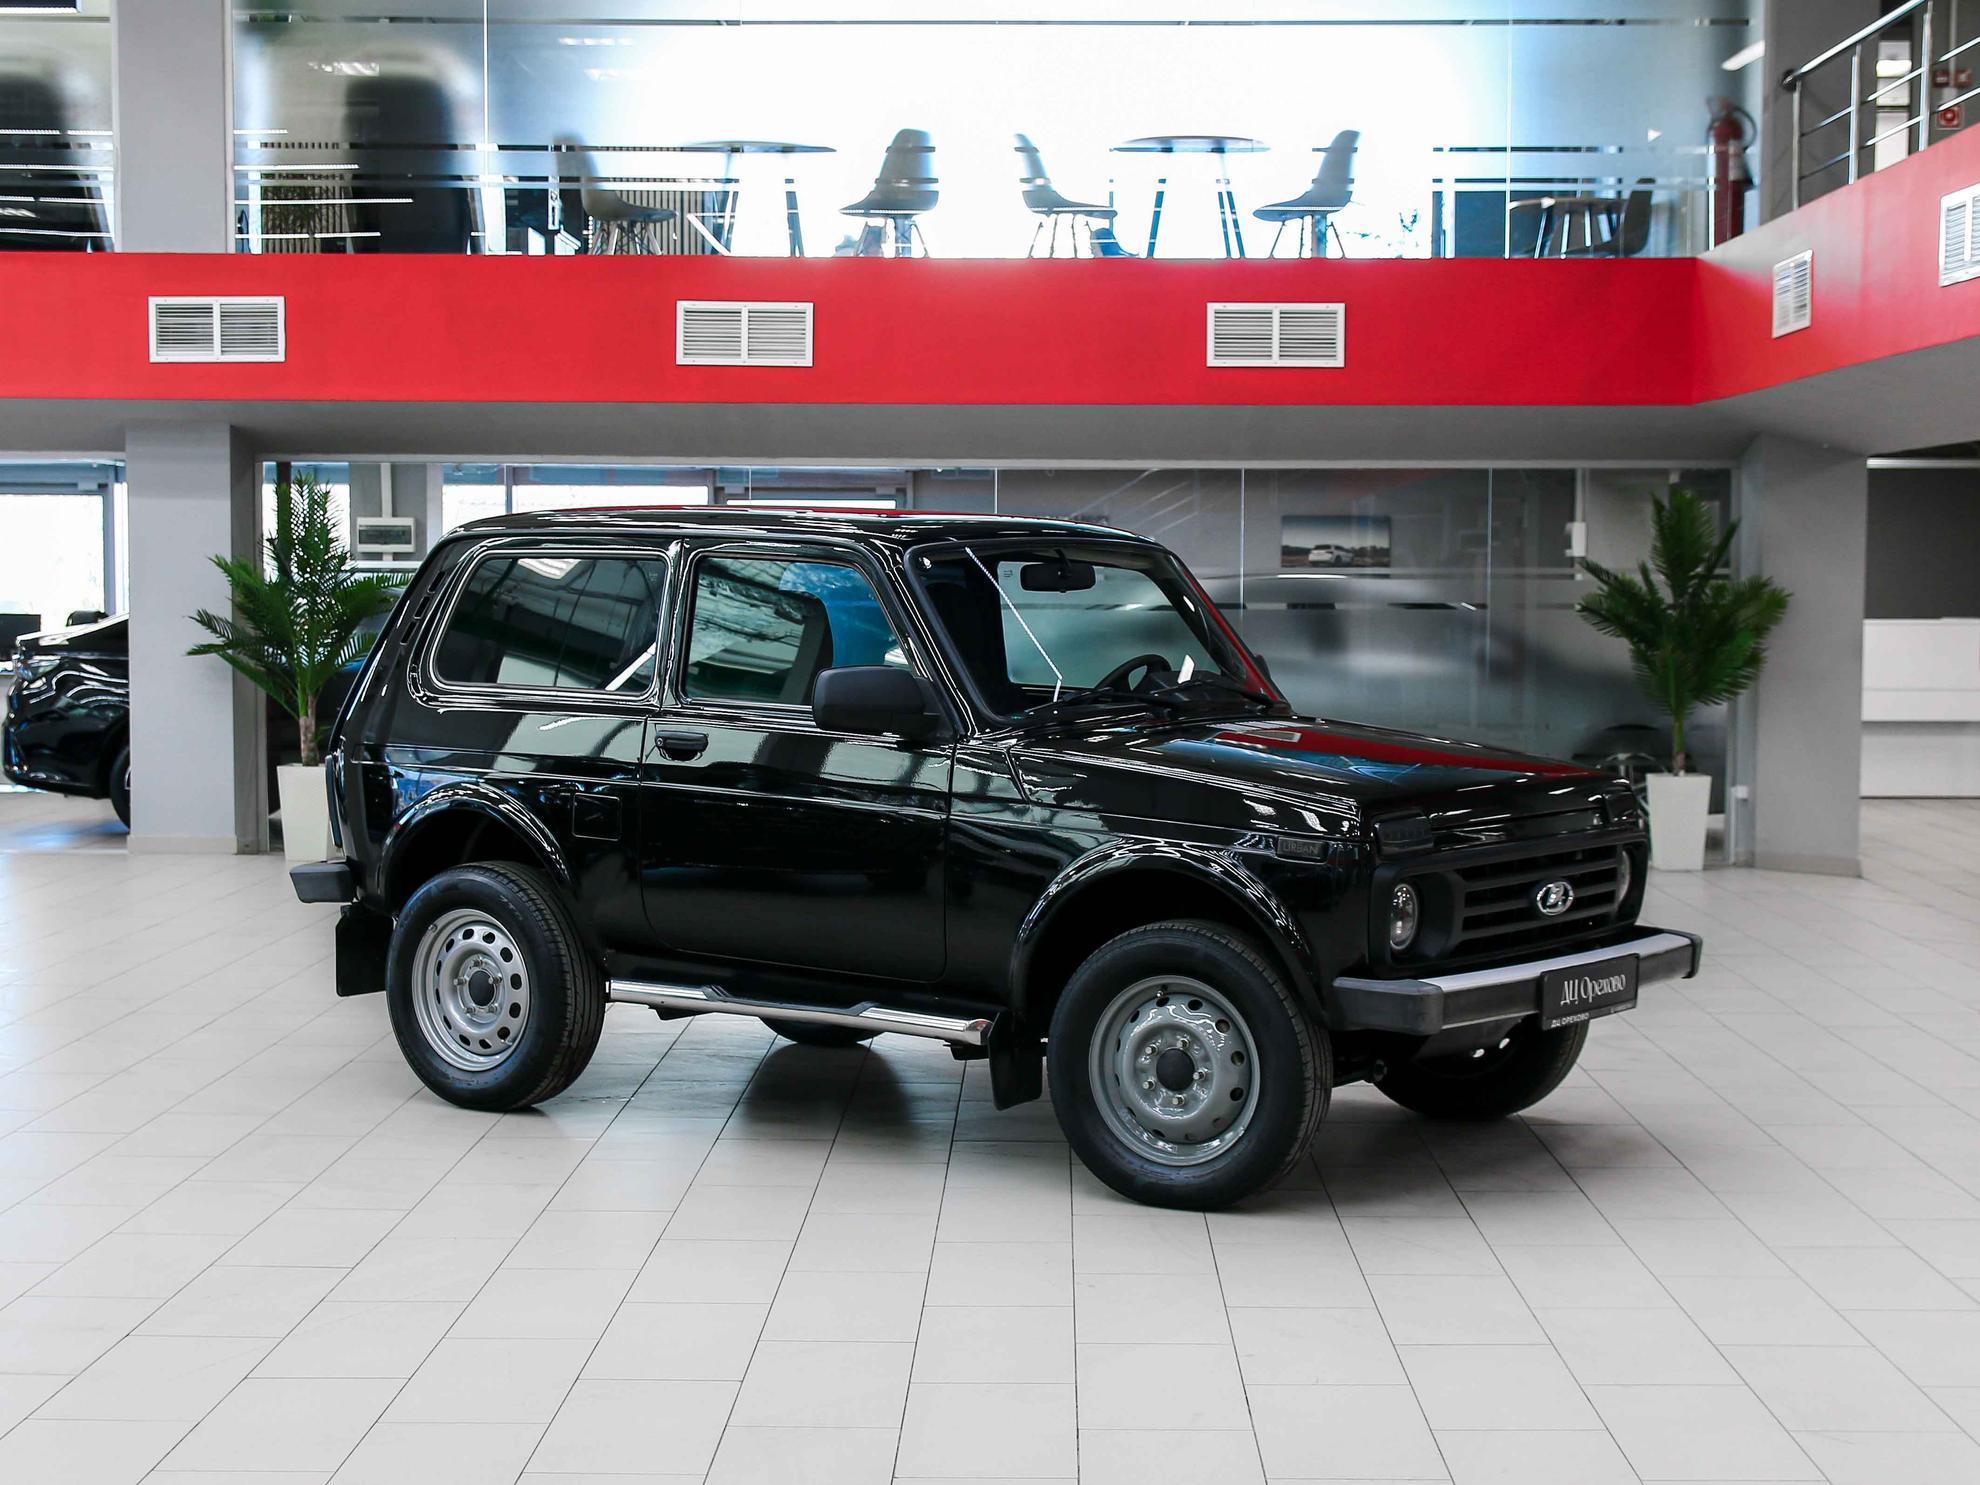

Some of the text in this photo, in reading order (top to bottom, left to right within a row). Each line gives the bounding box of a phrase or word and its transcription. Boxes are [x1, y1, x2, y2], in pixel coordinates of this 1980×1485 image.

[1283, 841, 1319, 855] URBAN
[1560, 974, 1626, 1006] ДЦ Орехово
[1561, 1012, 1590, 1025] ОРЕХОВО
